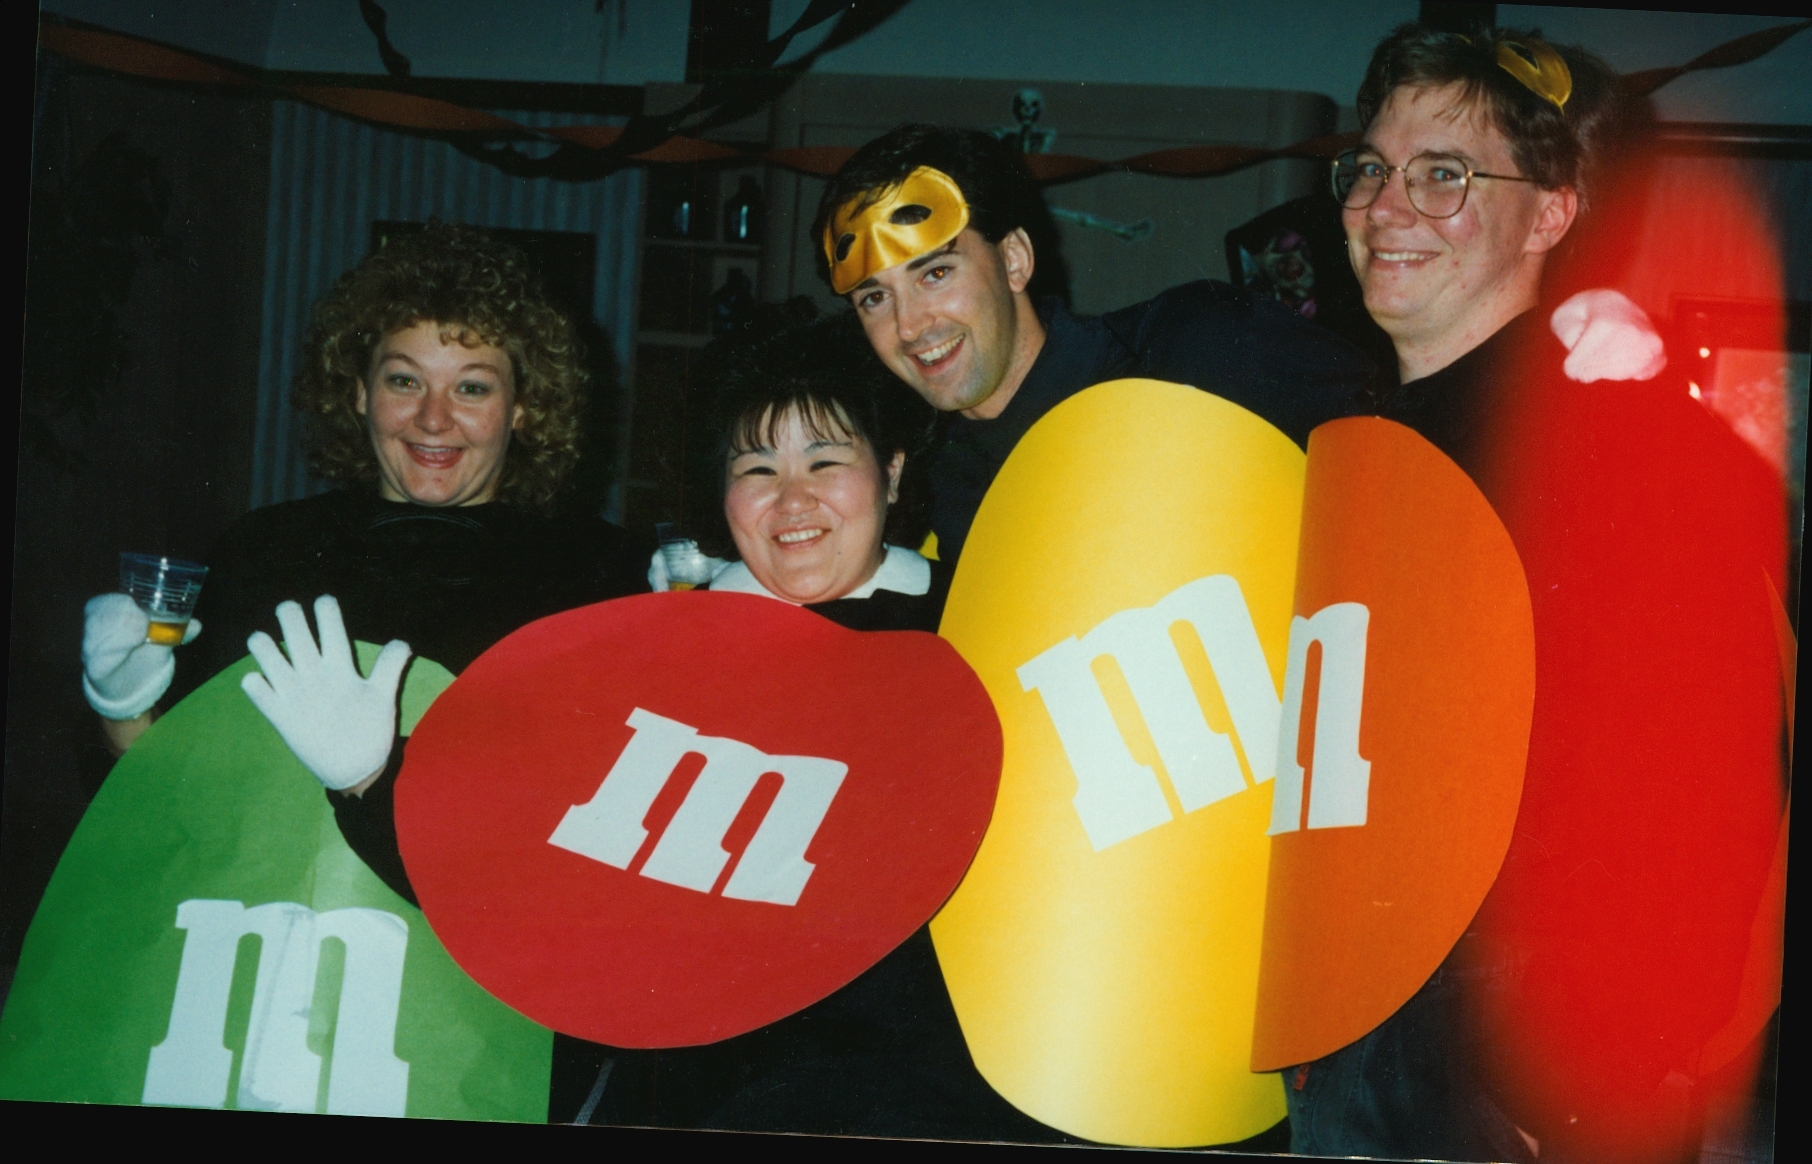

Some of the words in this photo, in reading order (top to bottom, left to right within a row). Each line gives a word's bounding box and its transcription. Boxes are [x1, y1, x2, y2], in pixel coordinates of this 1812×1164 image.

[548, 707, 849, 907] m
[1016, 574, 1283, 852] m
[142, 898, 411, 1117] m
